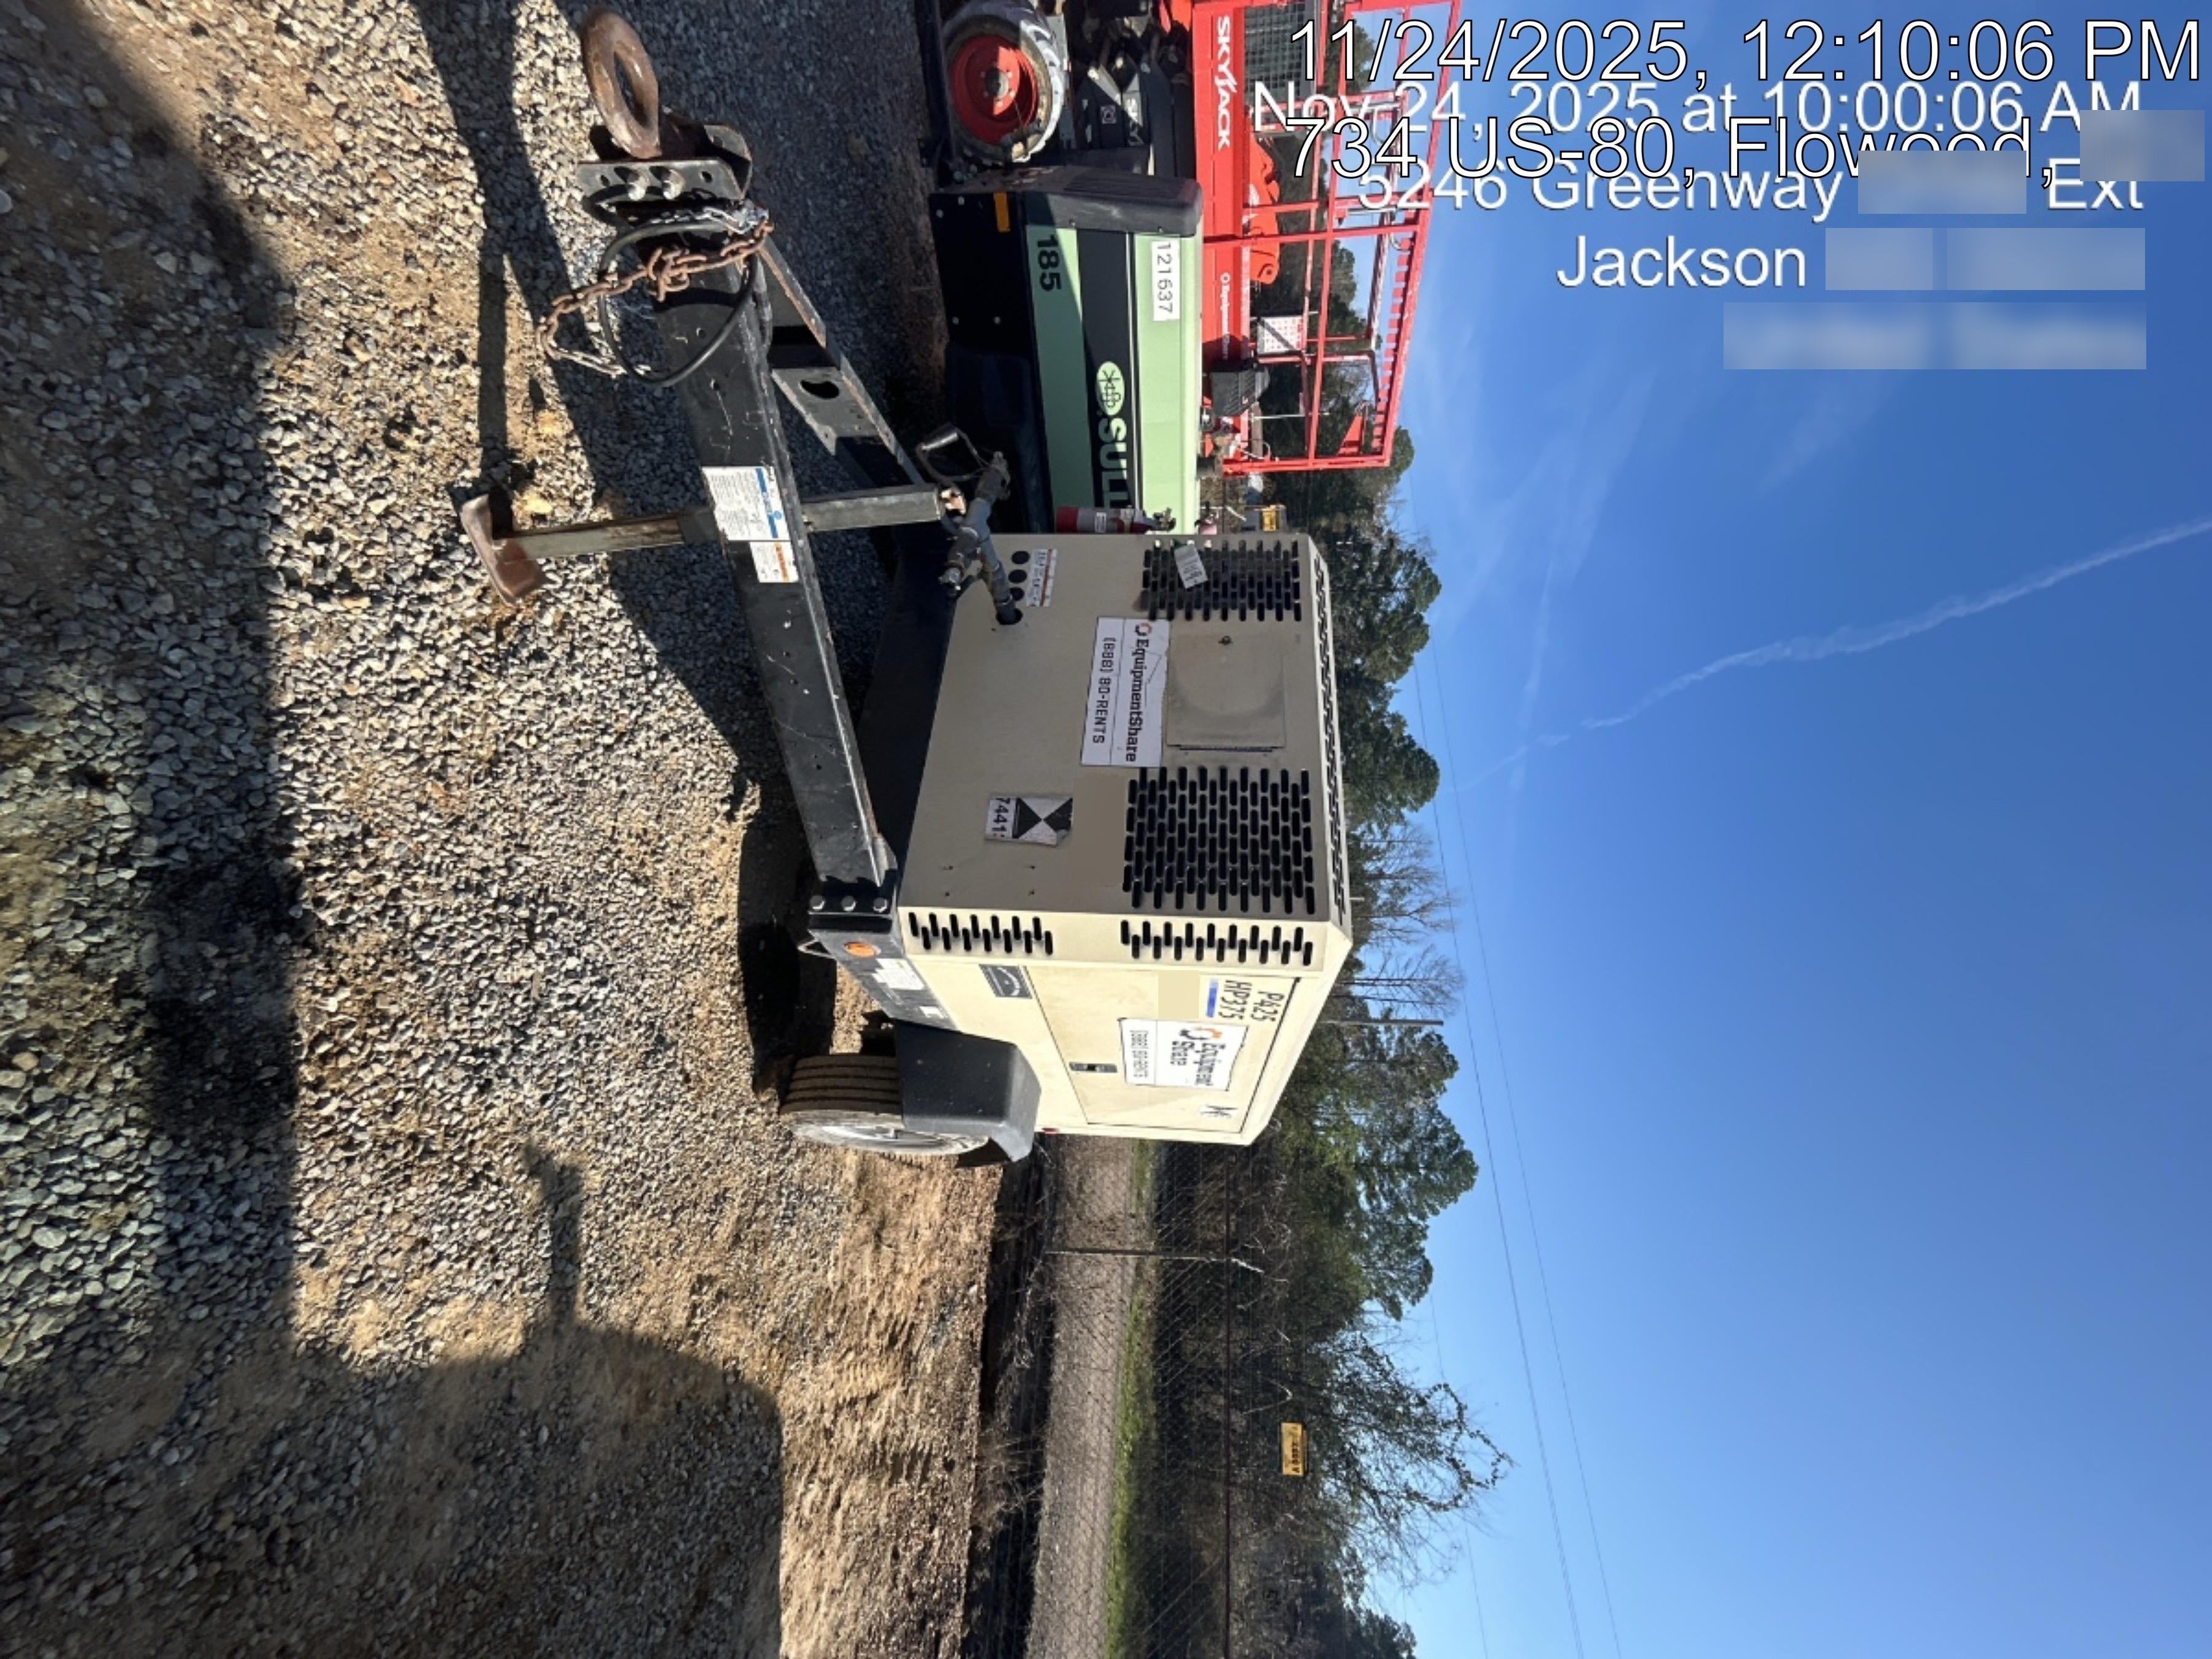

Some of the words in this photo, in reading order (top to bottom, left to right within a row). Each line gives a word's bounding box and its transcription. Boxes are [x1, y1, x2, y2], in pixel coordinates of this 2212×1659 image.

[1214, 15, 1237, 151] SKYJACK
[1037, 235, 1062, 291] 185
[1157, 243, 1173, 313] 121637
[1126, 638, 1150, 762] EquipmentShare
[1218, 980, 1252, 1020] HP375
[1250, 990, 1285, 1022] P425
